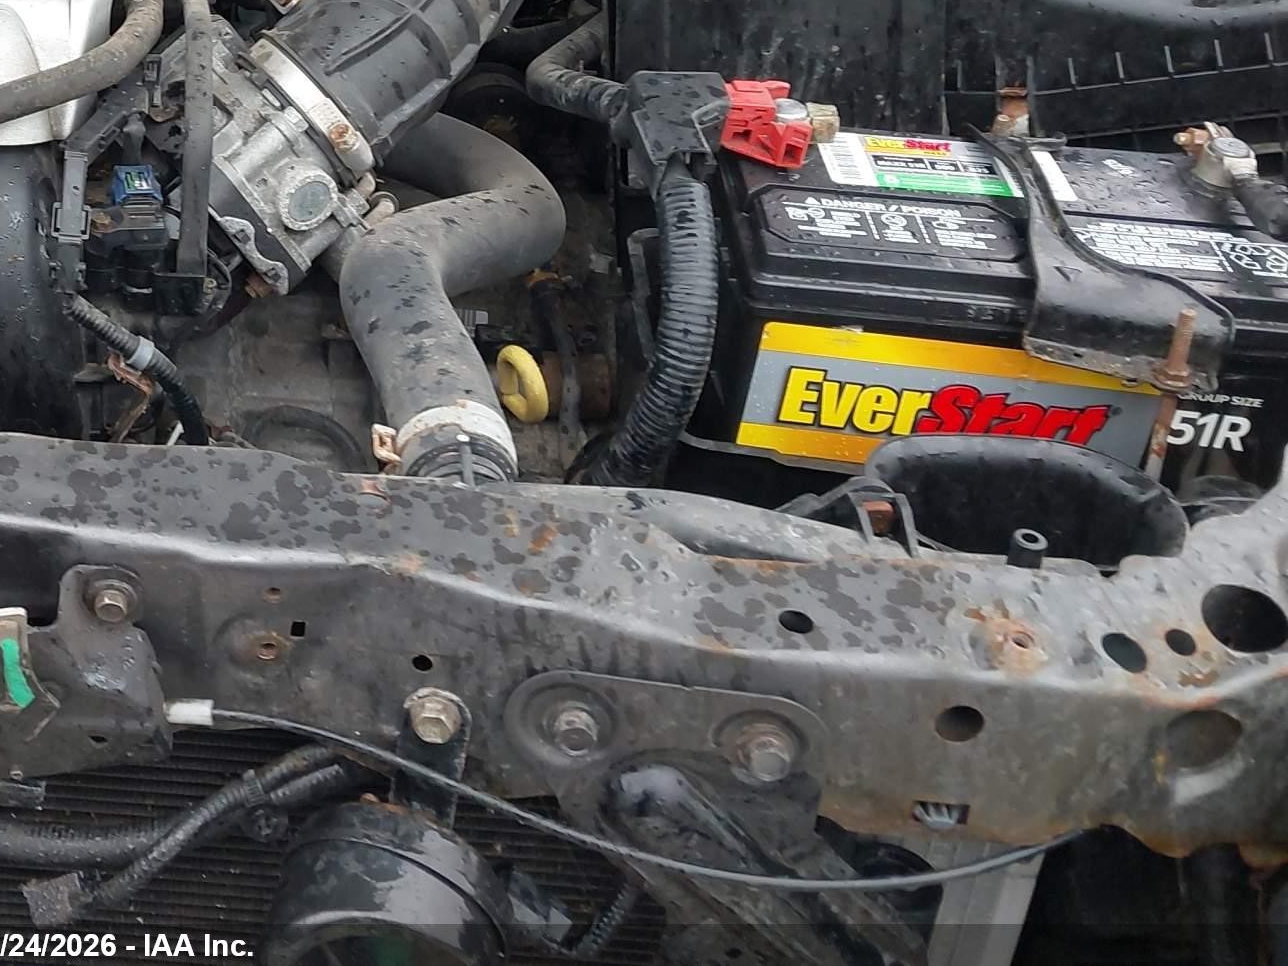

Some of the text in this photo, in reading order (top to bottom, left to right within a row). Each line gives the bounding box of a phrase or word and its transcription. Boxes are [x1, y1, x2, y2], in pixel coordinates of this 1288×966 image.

[866, 136, 951, 151] EverStart
[821, 198, 886, 211] DANGER
[901, 204, 962, 218] POISON
[777, 365, 1113, 447] EverStart
[1230, 396, 1264, 408] SIZE
[1166, 409, 1252, 452] 51R
